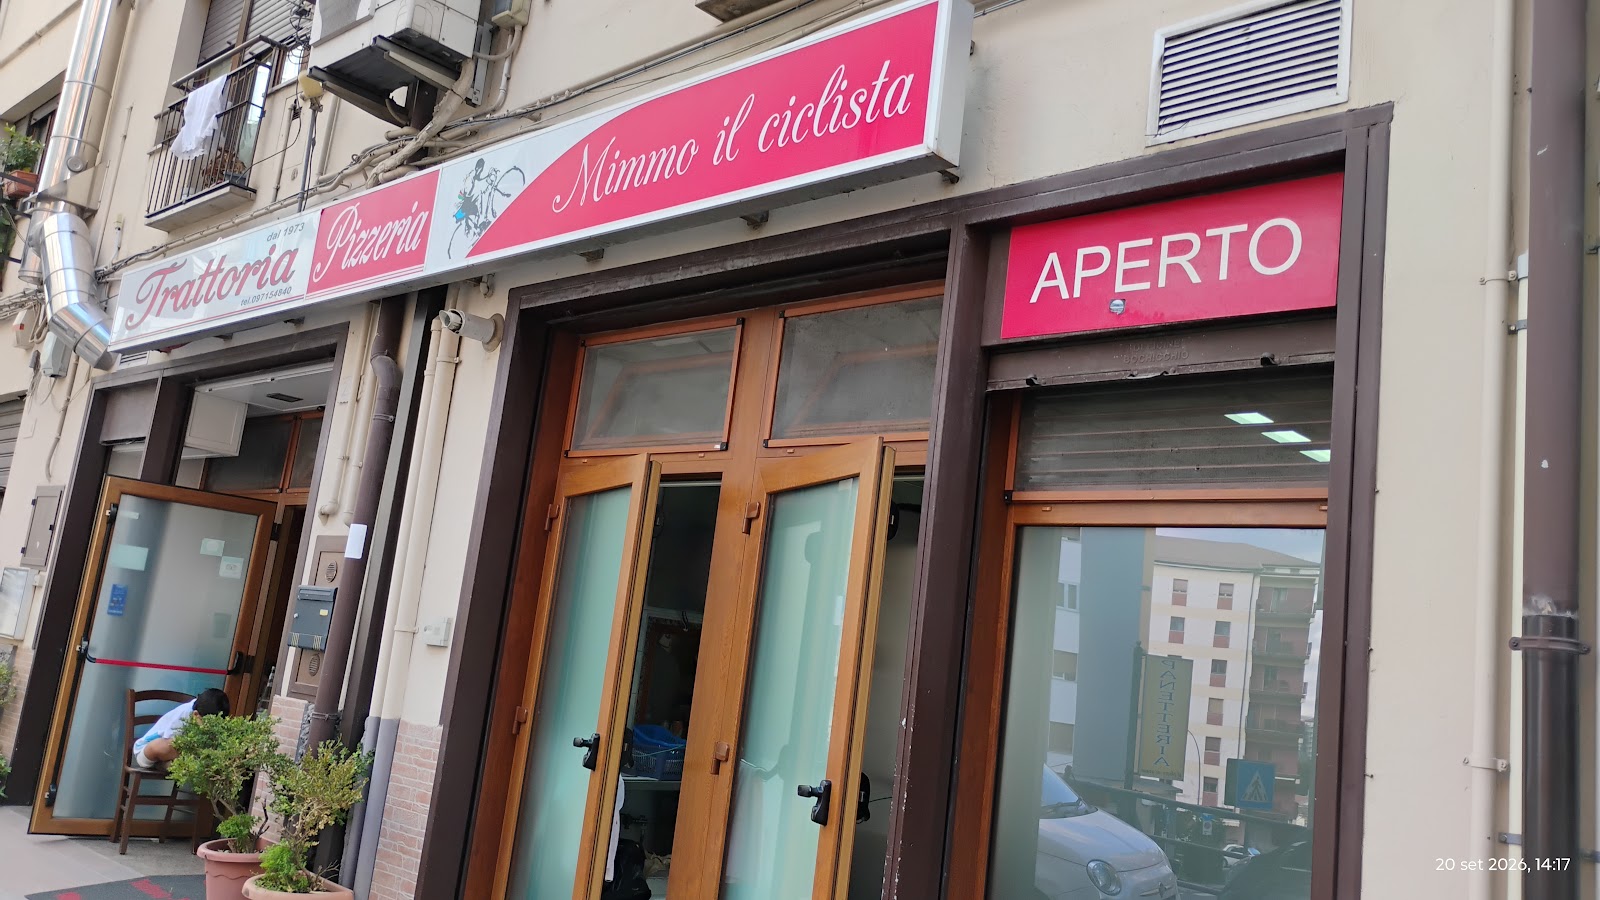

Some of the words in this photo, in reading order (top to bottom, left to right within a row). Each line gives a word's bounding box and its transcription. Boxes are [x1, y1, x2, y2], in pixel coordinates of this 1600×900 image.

[552, 136, 699, 213] Mimmo
[713, 94, 755, 166] il
[758, 60, 915, 153] ciclista
[267, 230, 282, 242] dal
[284, 222, 305, 236] 1973
[313, 201, 429, 284] Pizzeria
[1029, 218, 1302, 304] APERTO
[125, 244, 299, 331] Trattoria
